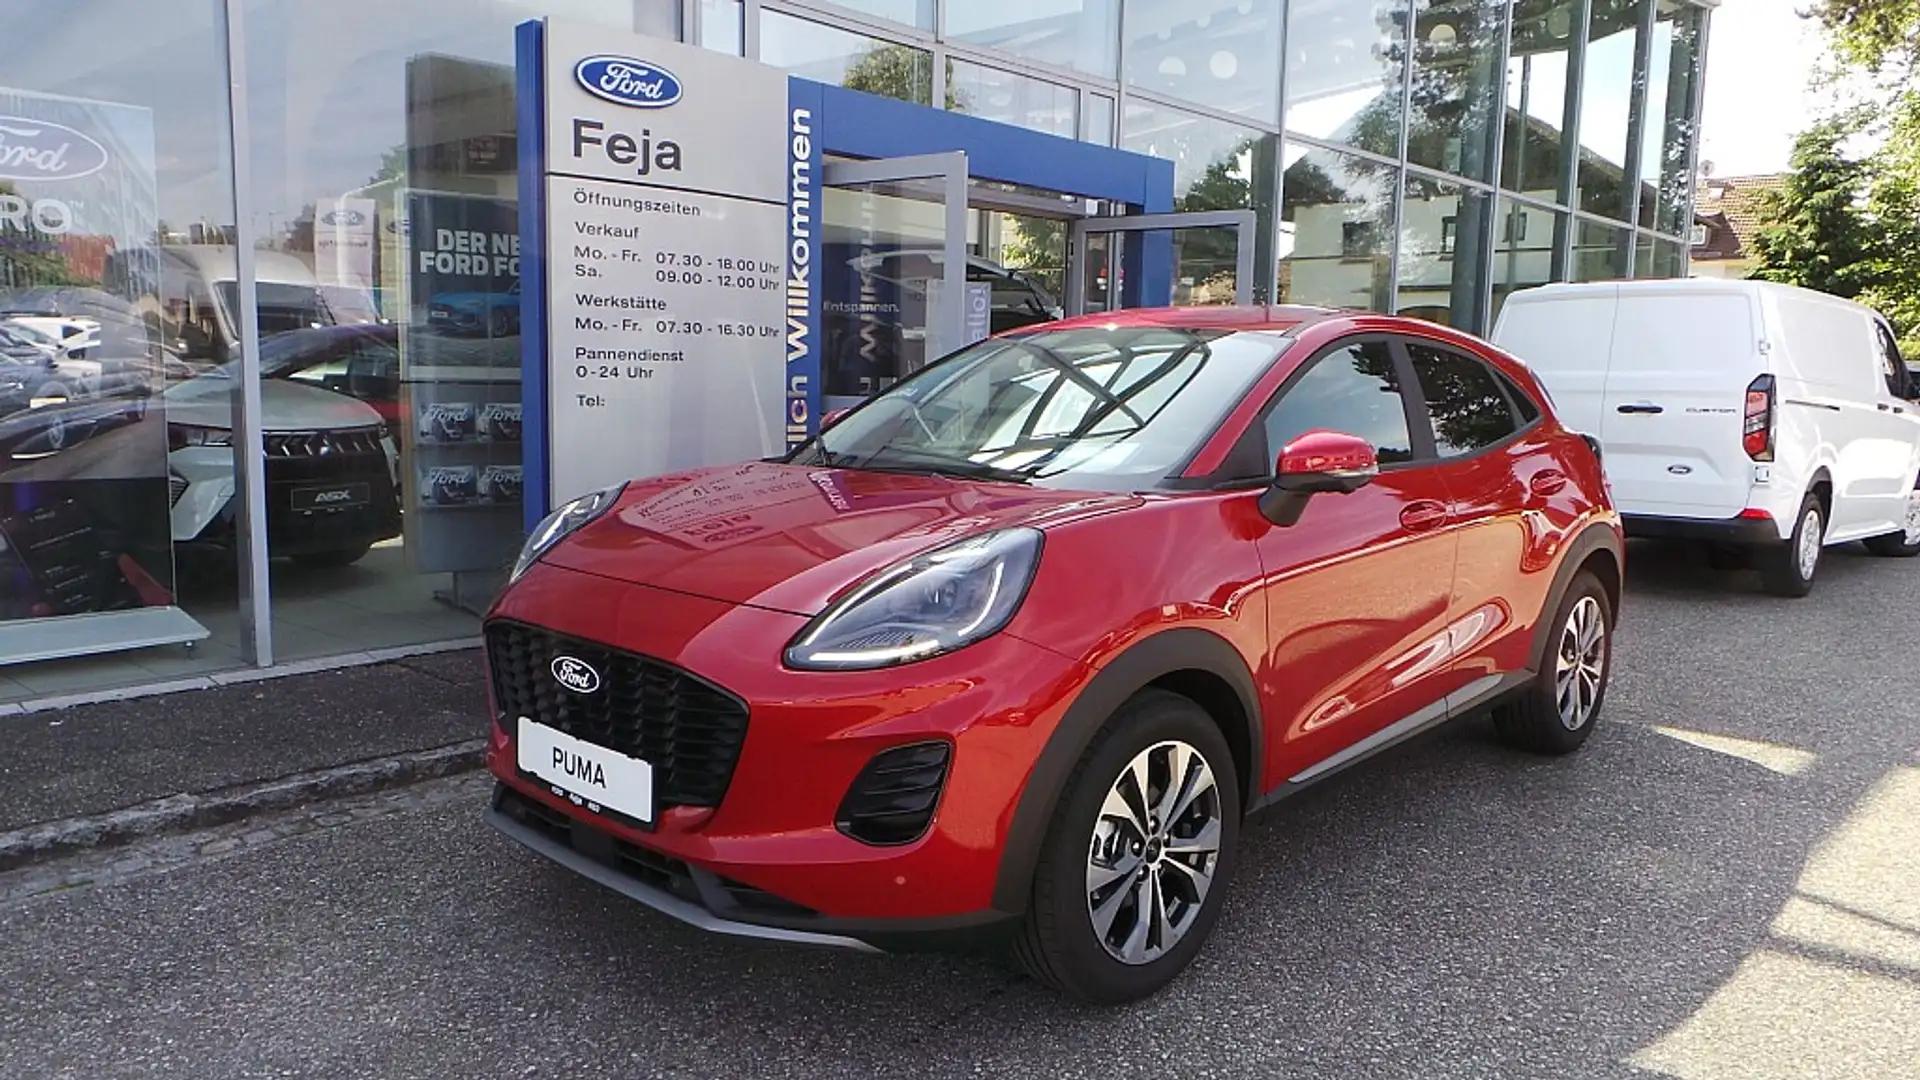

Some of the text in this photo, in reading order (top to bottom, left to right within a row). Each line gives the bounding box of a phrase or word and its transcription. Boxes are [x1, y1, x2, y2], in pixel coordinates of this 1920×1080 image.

[600, 62, 663, 100] Ford
[573, 119, 682, 175] Feja
[574, 188, 701, 217] Öffnungszeiten
[437, 229, 487, 254] DER
[575, 221, 640, 239] Verkauf
[420, 251, 489, 276] FORD
[656, 251, 702, 268] 07.30
[717, 258, 755, 273] 18.00
[759, 261, 780, 274] Uhr
[575, 264, 602, 278] Sa.
[656, 269, 702, 285] 09.00
[717, 274, 755, 289] 12.00
[759, 278, 780, 291] Uhr
[788, 108, 811, 448] lich Willkommen
[575, 293, 667, 311] Werkstätte
[656, 320, 702, 336] 07.30
[717, 323, 755, 338] 16.30
[759, 325, 780, 338] Uhr
[575, 346, 684, 363] Pannendienst
[627, 366, 654, 379] Uhr
[577, 394, 606, 408] Tel:
[558, 660, 591, 688] Ford
[552, 746, 607, 789] PUMA
